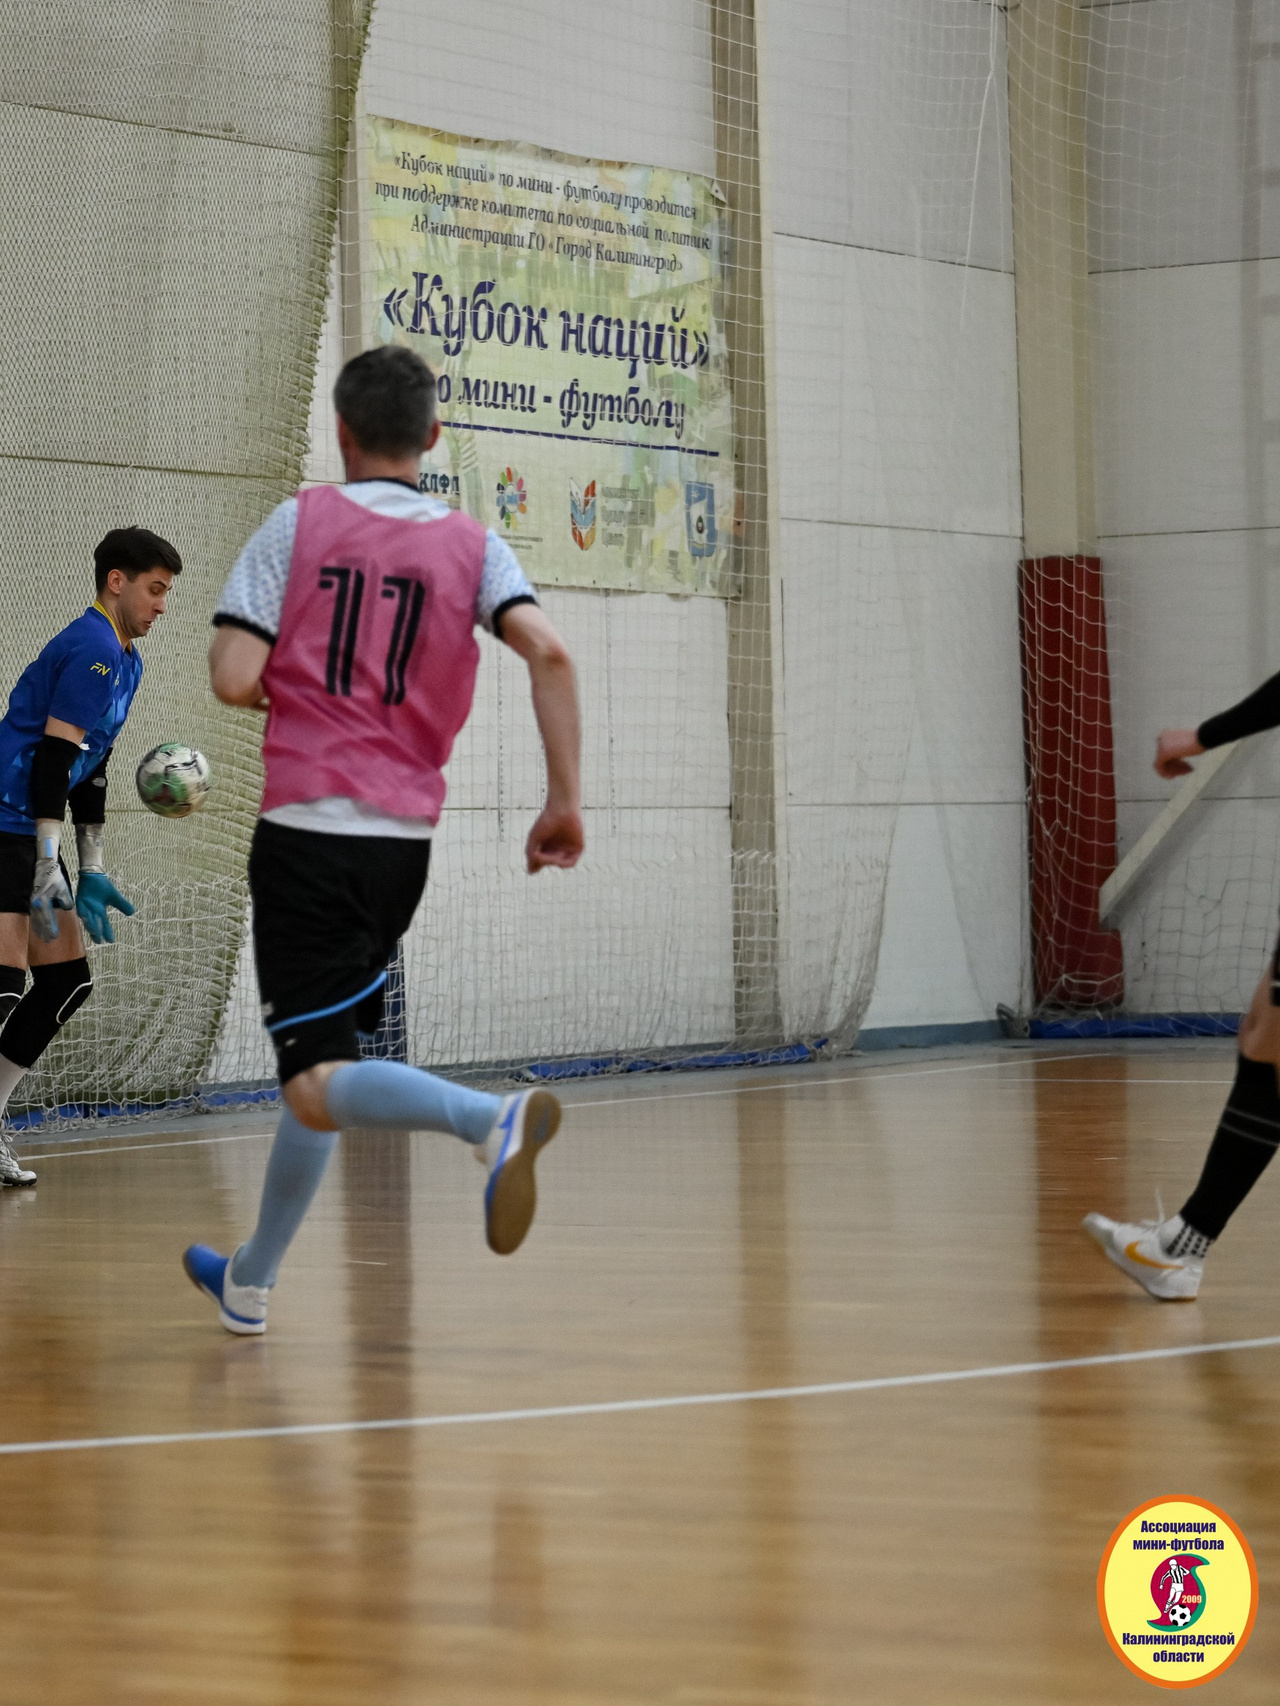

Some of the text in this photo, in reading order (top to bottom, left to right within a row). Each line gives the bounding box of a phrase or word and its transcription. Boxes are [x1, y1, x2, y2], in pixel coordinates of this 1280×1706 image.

[375, 181, 399, 202] при
[402, 183, 478, 212] поддержке
[481, 200, 554, 224] комитета
[558, 211, 574, 227] по
[576, 214, 649, 239] социальной
[394, 151, 443, 176] «Кубок
[446, 164, 495, 186] наций»
[499, 173, 514, 188] по
[516, 177, 553, 195] мини
[563, 180, 622, 210] футболу
[624, 195, 697, 220] проводится
[411, 214, 683, 275] Администрации ГО «Город Калининград»
[383, 271, 710, 379] «Кубок наций»
[437, 373, 452, 404] о
[457, 374, 537, 414] мини
[558, 378, 685, 440] футболу
[317, 566, 426, 706] 11
